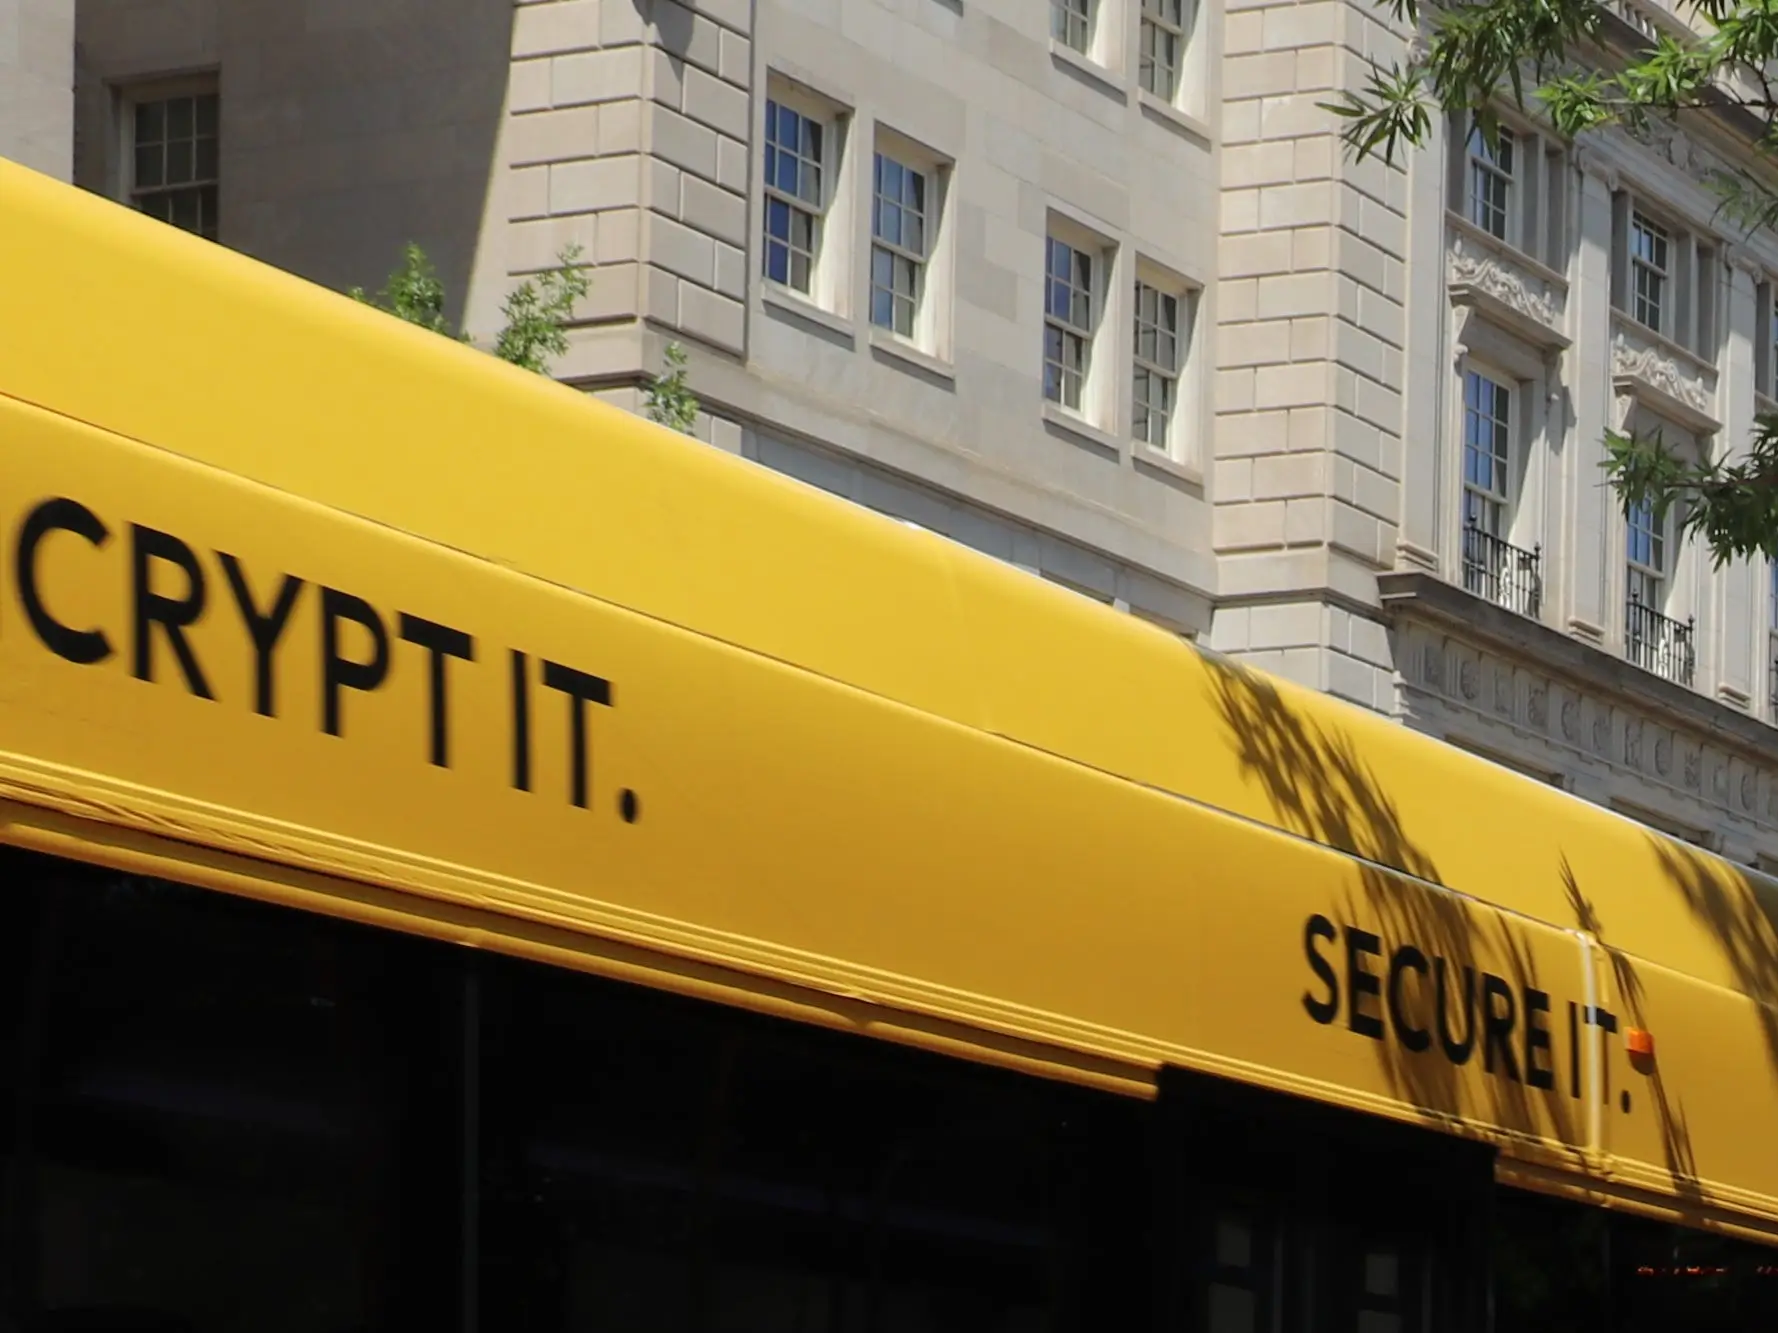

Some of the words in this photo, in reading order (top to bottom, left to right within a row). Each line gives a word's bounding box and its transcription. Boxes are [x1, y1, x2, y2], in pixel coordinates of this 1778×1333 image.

[510, 647, 643, 825] IT.
[1303, 912, 1552, 1088] SECURE
[1568, 995, 1633, 1114] IT.
